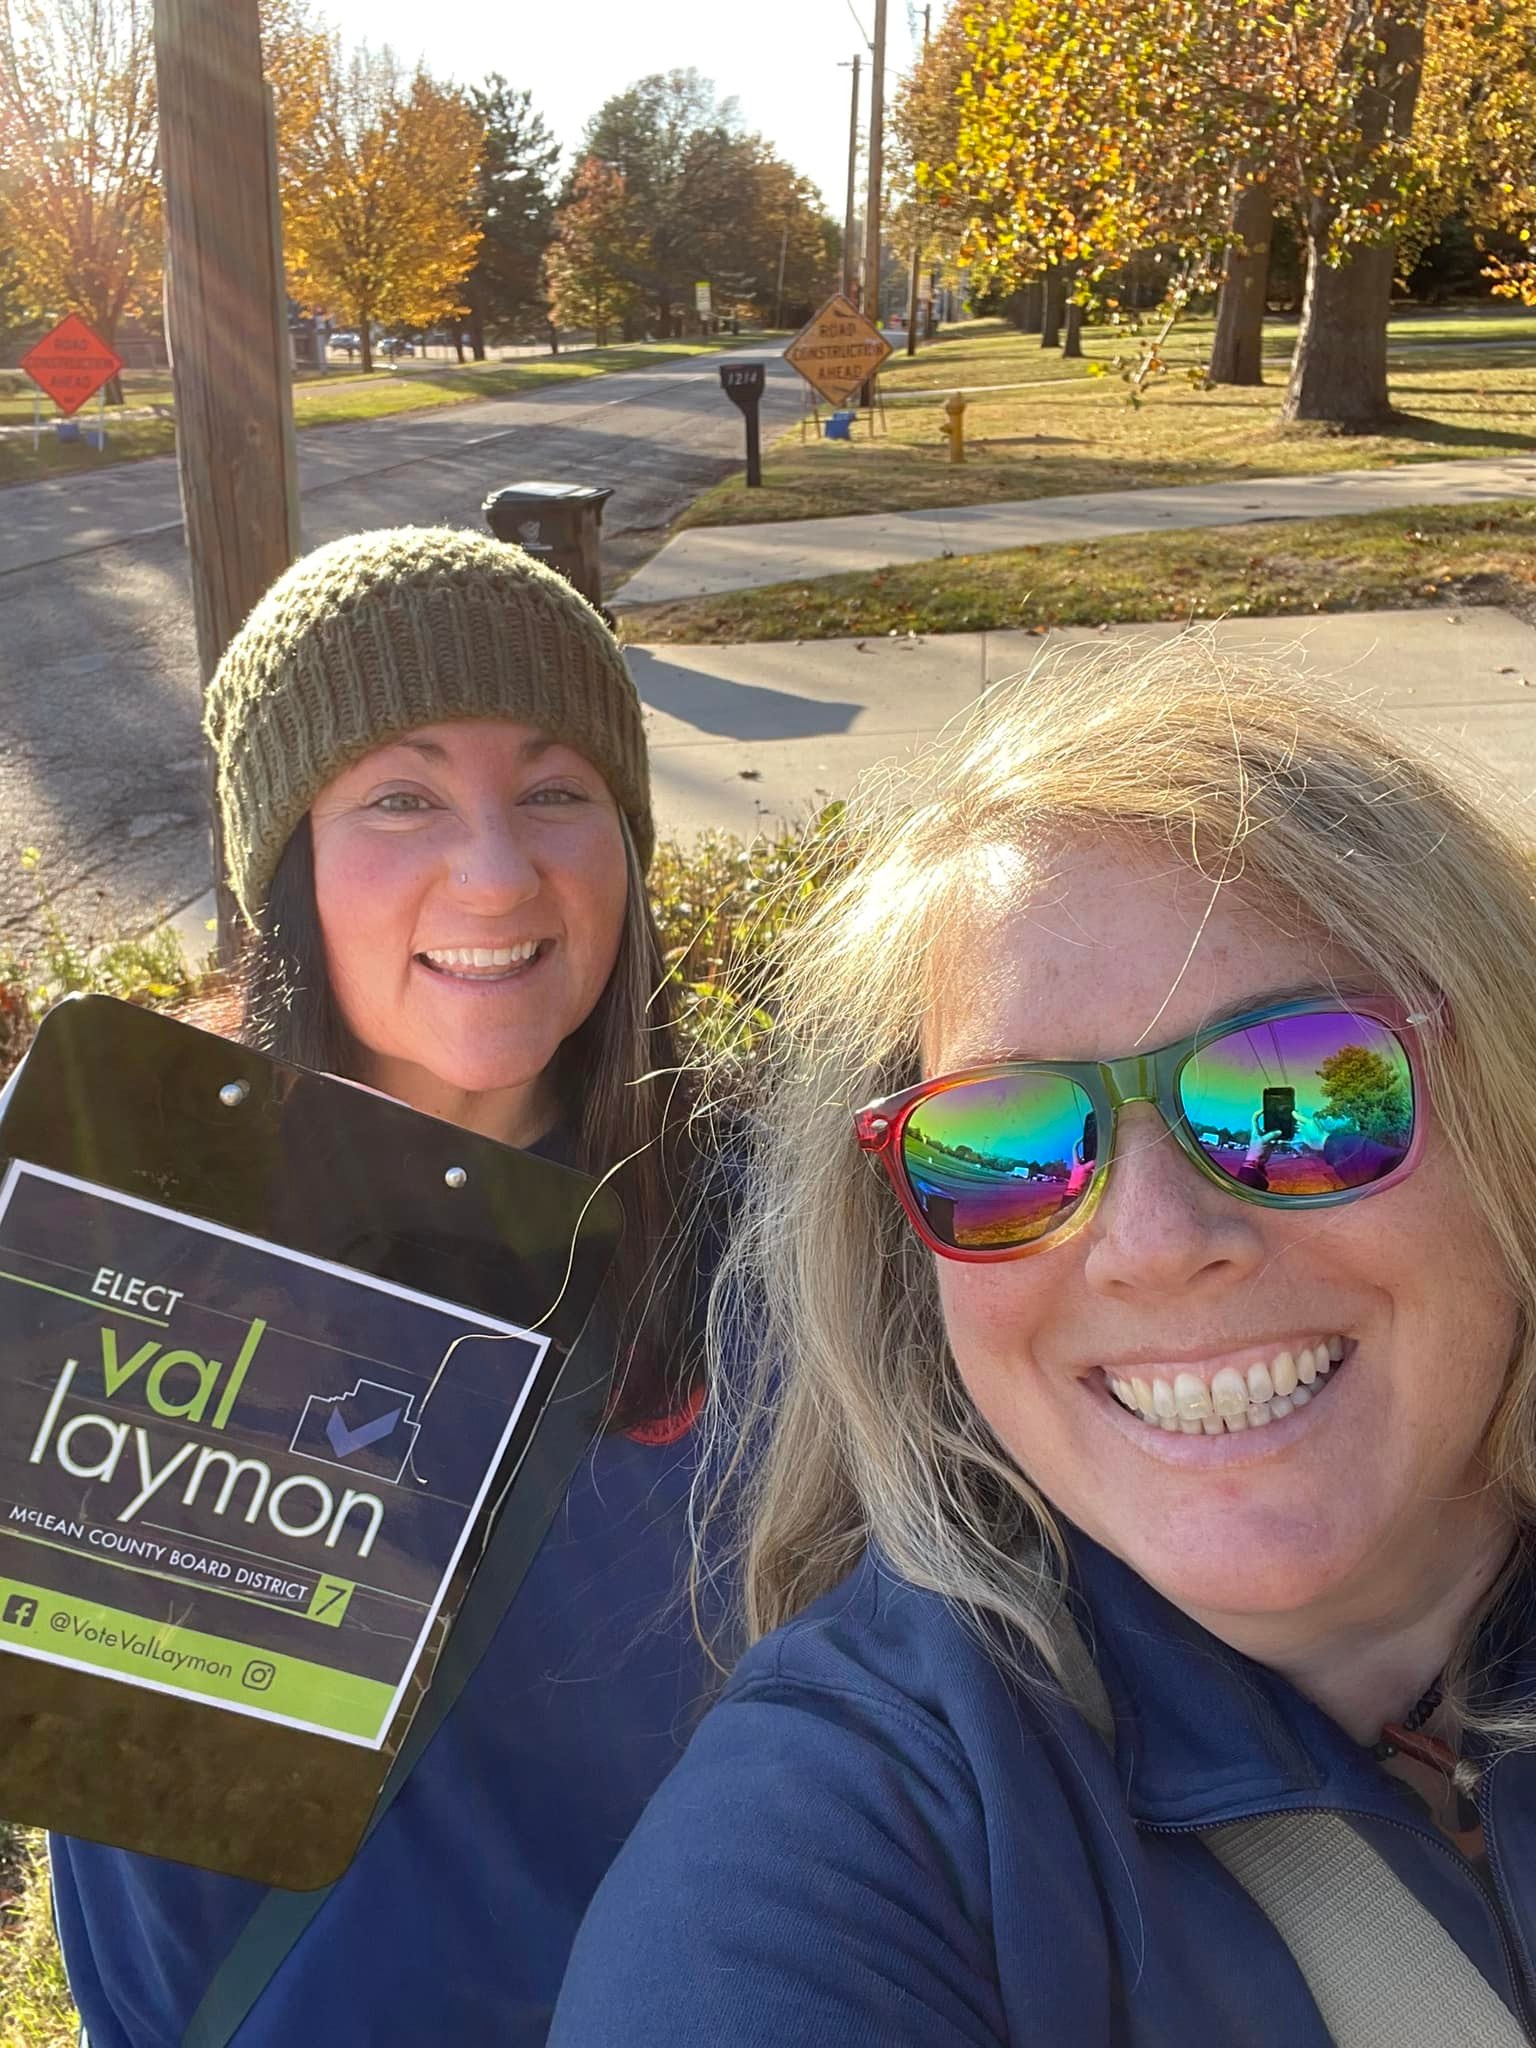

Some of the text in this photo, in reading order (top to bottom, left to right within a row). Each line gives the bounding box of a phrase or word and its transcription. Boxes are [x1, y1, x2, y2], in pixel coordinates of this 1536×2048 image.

[792, 343, 884, 361] CONSTRUCTION
[819, 323, 857, 338] ROAD
[818, 365, 863, 380] AHEAD
[91, 1267, 184, 1317] ELECT
[102, 1318, 267, 1430] val
[29, 1358, 385, 1558] laymon
[88, 1529, 168, 1562] COUNTY
[169, 1551, 232, 1580] BOARD
[234, 1568, 309, 1601] DISTRICT
[314, 1584, 348, 1617] 7
[49, 1610, 233, 1679] @VoteValLaymon
